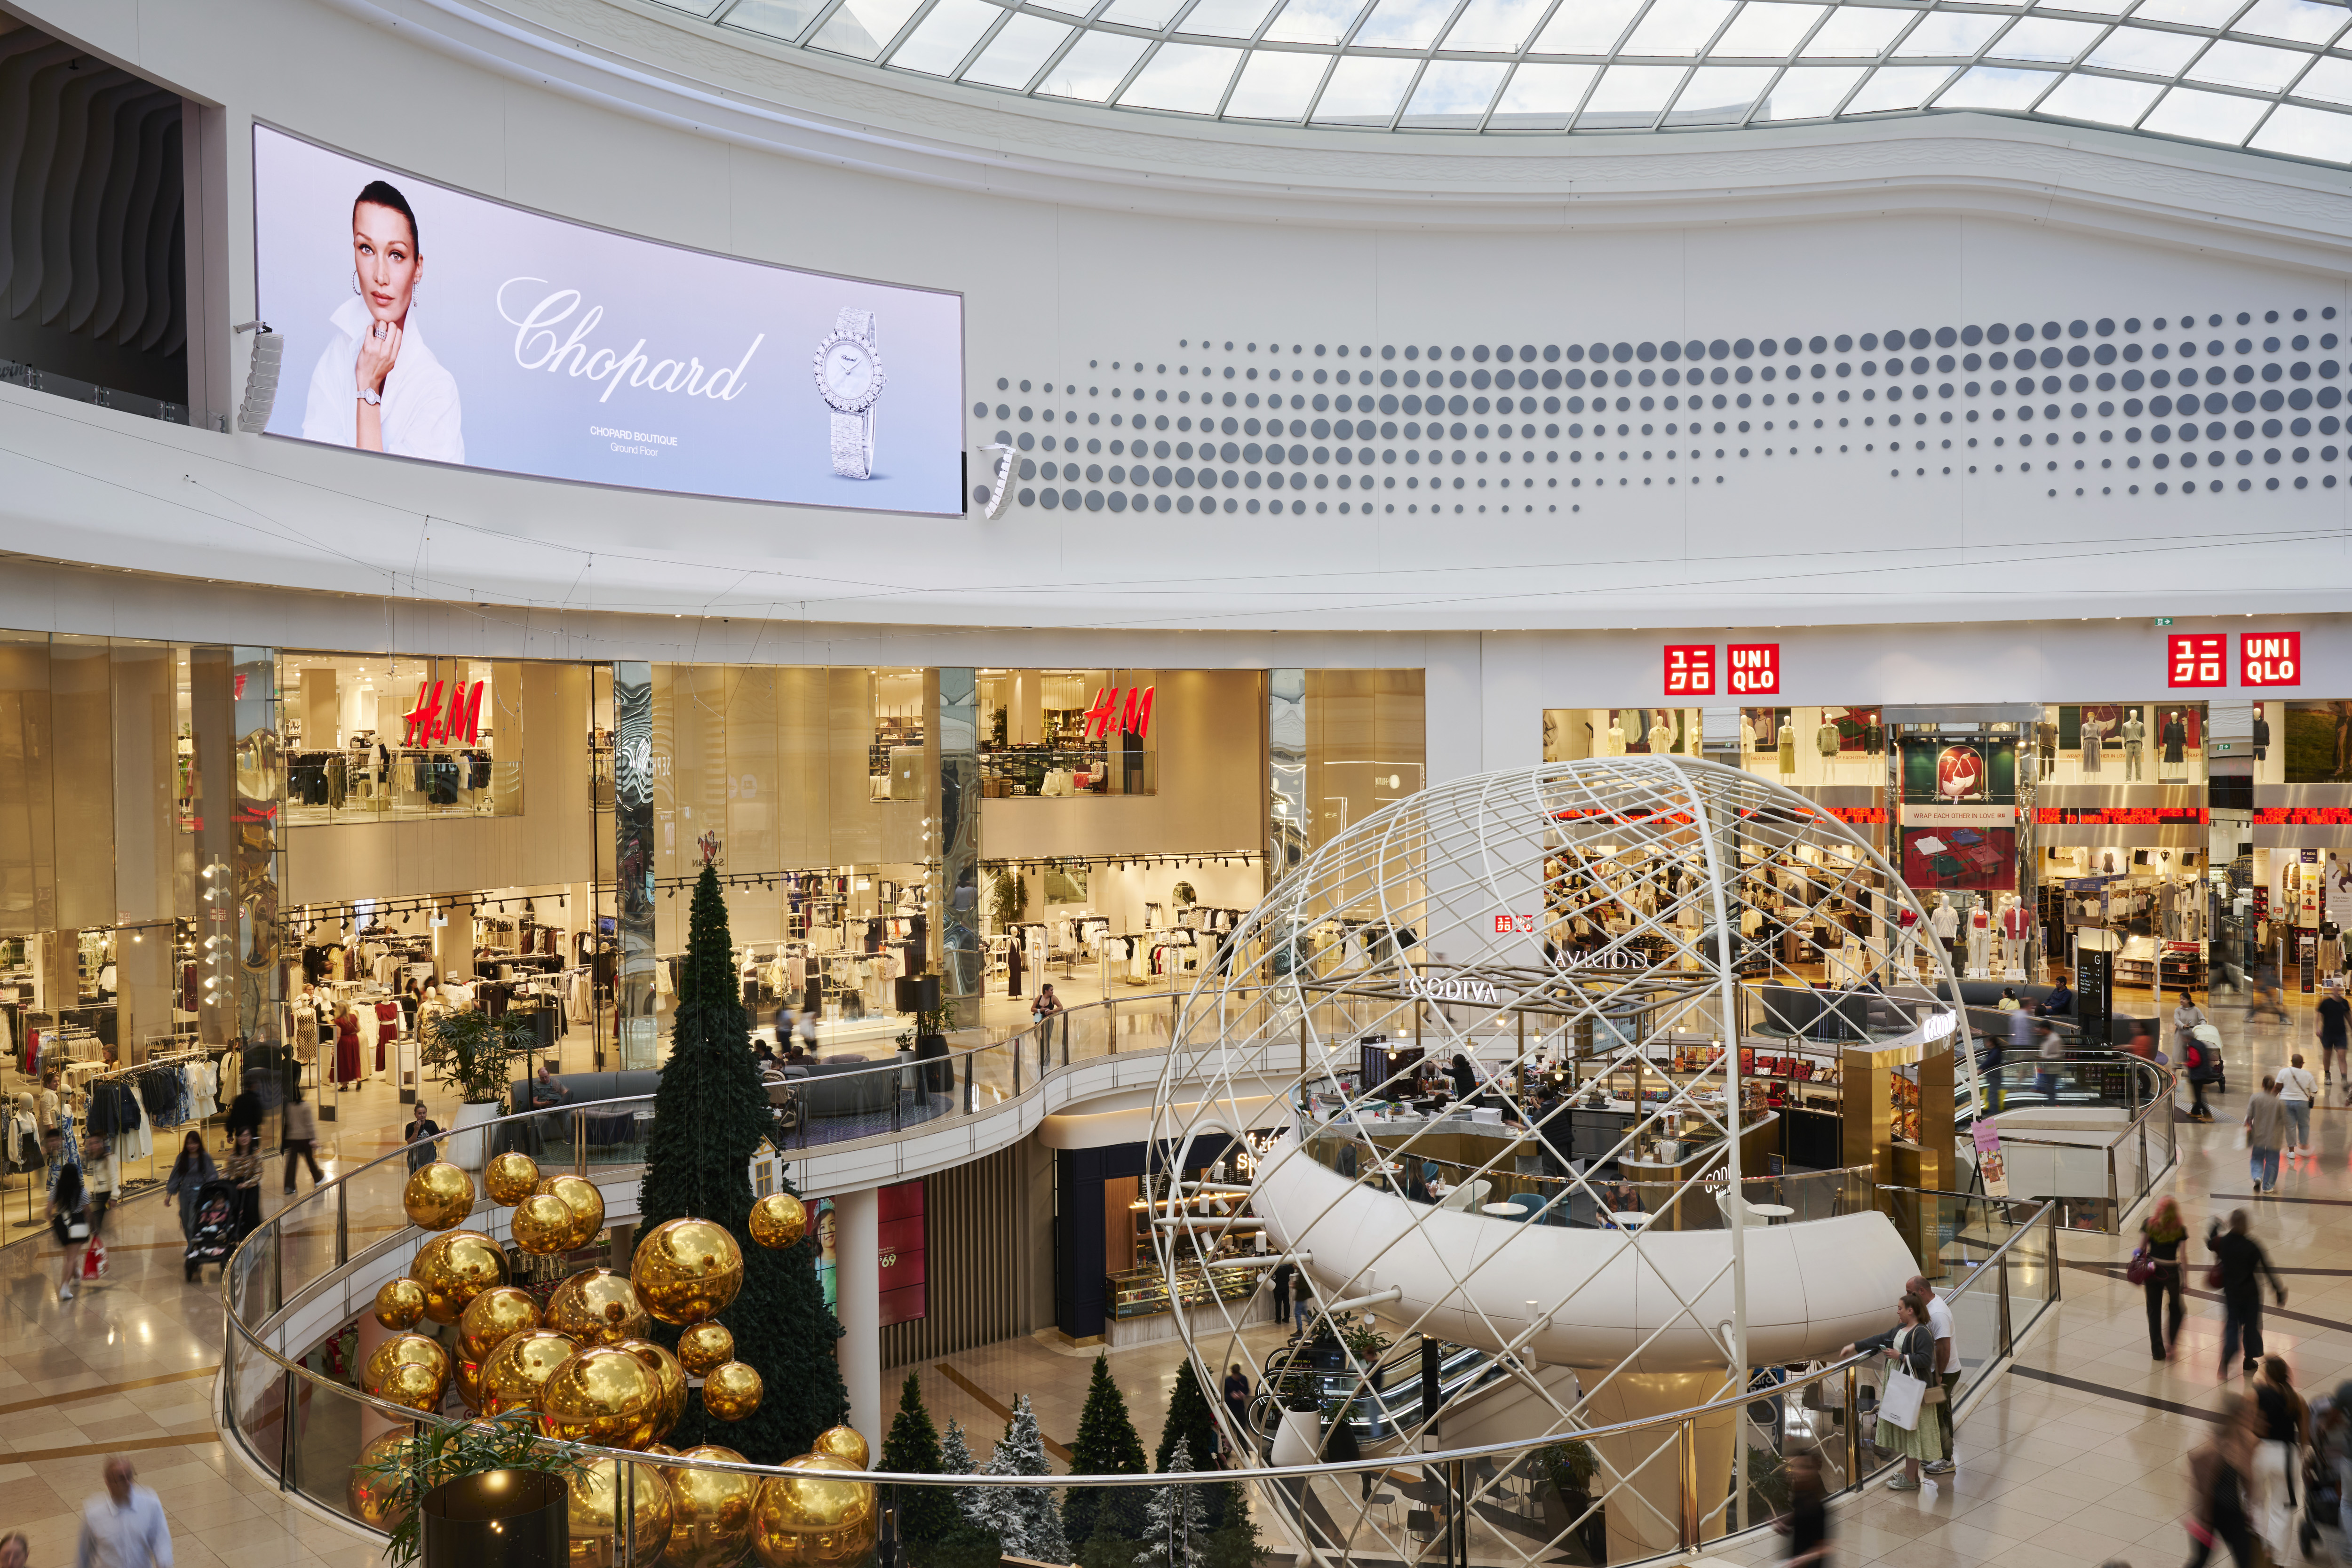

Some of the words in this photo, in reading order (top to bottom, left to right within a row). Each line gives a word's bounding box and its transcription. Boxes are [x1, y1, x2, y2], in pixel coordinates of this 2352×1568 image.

[496, 276, 765, 403] Chopard
[590, 426, 632, 440] CHOPARD
[634, 432, 677, 446] BOUTIQUE
[611, 442, 638, 454] Ground
[640, 446, 659, 456] Floor
[2247, 639, 2289, 658] UNI
[1733, 650, 1770, 668] UNI
[1733, 670, 1774, 692] QLO
[2247, 661, 2294, 683] QLO
[405, 680, 484, 749] H&M
[1083, 687, 1154, 739] H&M
[2254, 815, 2286, 824] ELCOME
[2094, 955, 2100, 964] G
[1408, 976, 1497, 1003] GODIVA
[879, 1253, 897, 1267] $69
